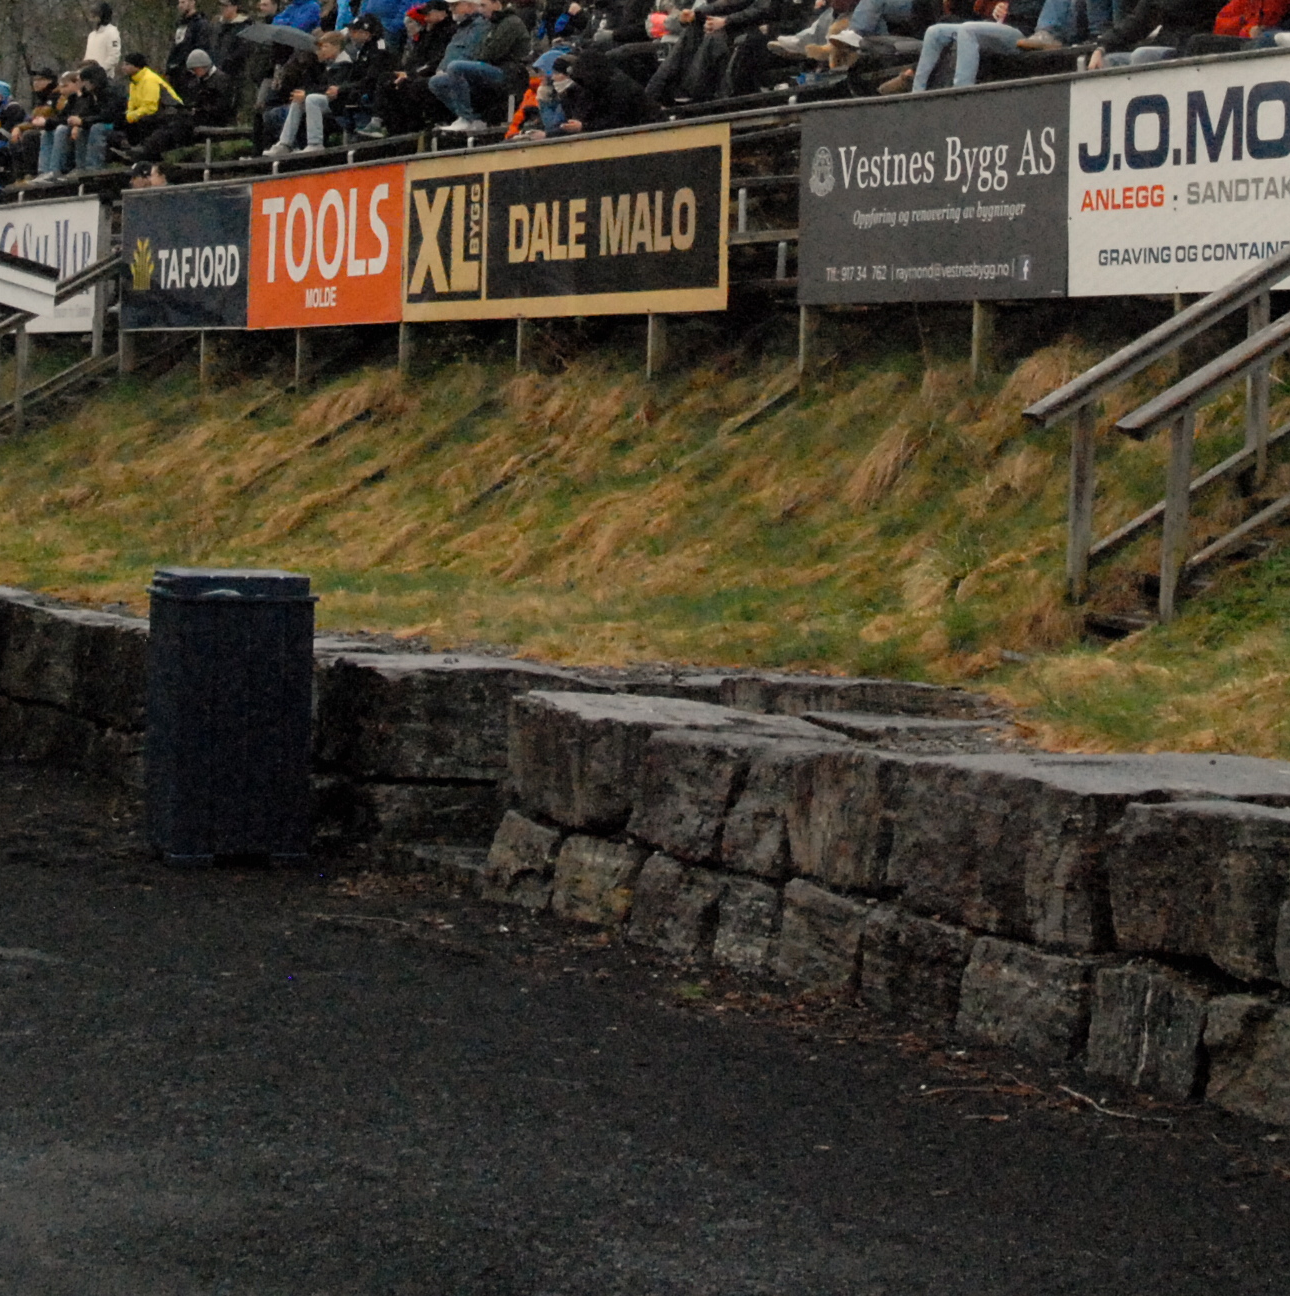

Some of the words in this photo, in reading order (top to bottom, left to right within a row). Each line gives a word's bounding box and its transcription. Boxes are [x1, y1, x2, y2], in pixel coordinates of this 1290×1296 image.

[838, 145, 935, 190] Vestnes
[944, 136, 1009, 194] Bygg
[1017, 126, 1056, 176] AS
[469, 183, 482, 255] BYGG
[898, 210, 910, 227] og
[976, 200, 1027, 222] bygninger
[1080, 184, 1165, 212] ANLEGG
[262, 183, 389, 283] TOOLS
[409, 185, 480, 294] XL
[509, 198, 588, 264] DALE
[599, 187, 697, 257] MALO
[158, 244, 240, 290] TAFJORD
[841, 266, 855, 282] 917
[856, 266, 867, 281] 34
[872, 265, 887, 281] 762
[1098, 245, 1171, 267] GRAVING
[1175, 244, 1198, 263] OG
[305, 286, 337, 309] MOLDE
